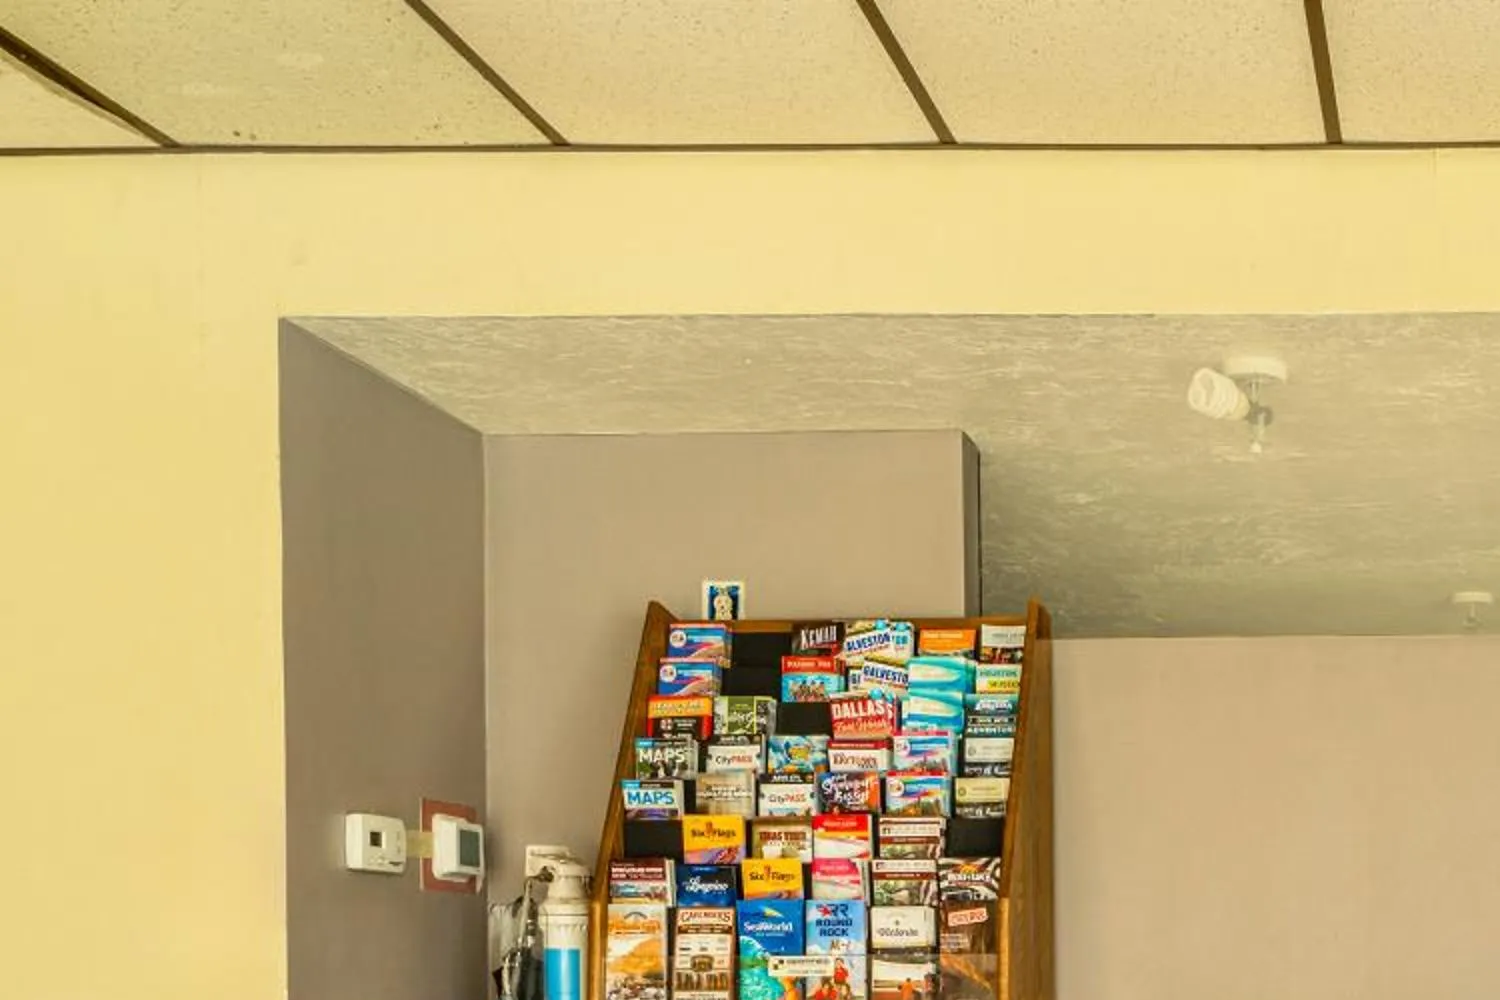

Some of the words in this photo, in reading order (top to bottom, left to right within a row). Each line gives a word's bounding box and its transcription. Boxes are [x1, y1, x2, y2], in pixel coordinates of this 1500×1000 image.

[801, 625, 837, 650] KEMAH
[832, 698, 885, 720] DALLAS
[639, 747, 687, 763] MAPS
[715, 755, 753, 765] CityPASS
[628, 791, 675, 805] MAPS
[768, 793, 807, 804] CityPASS
[690, 828, 705, 838] Six
[712, 828, 737, 840] Flags
[748, 871, 765, 881] Six
[771, 871, 796, 884] Flags
[743, 921, 794, 932] SeaWorld
[816, 918, 853, 927] ROUND
[819, 927, 849, 937] ROCK
